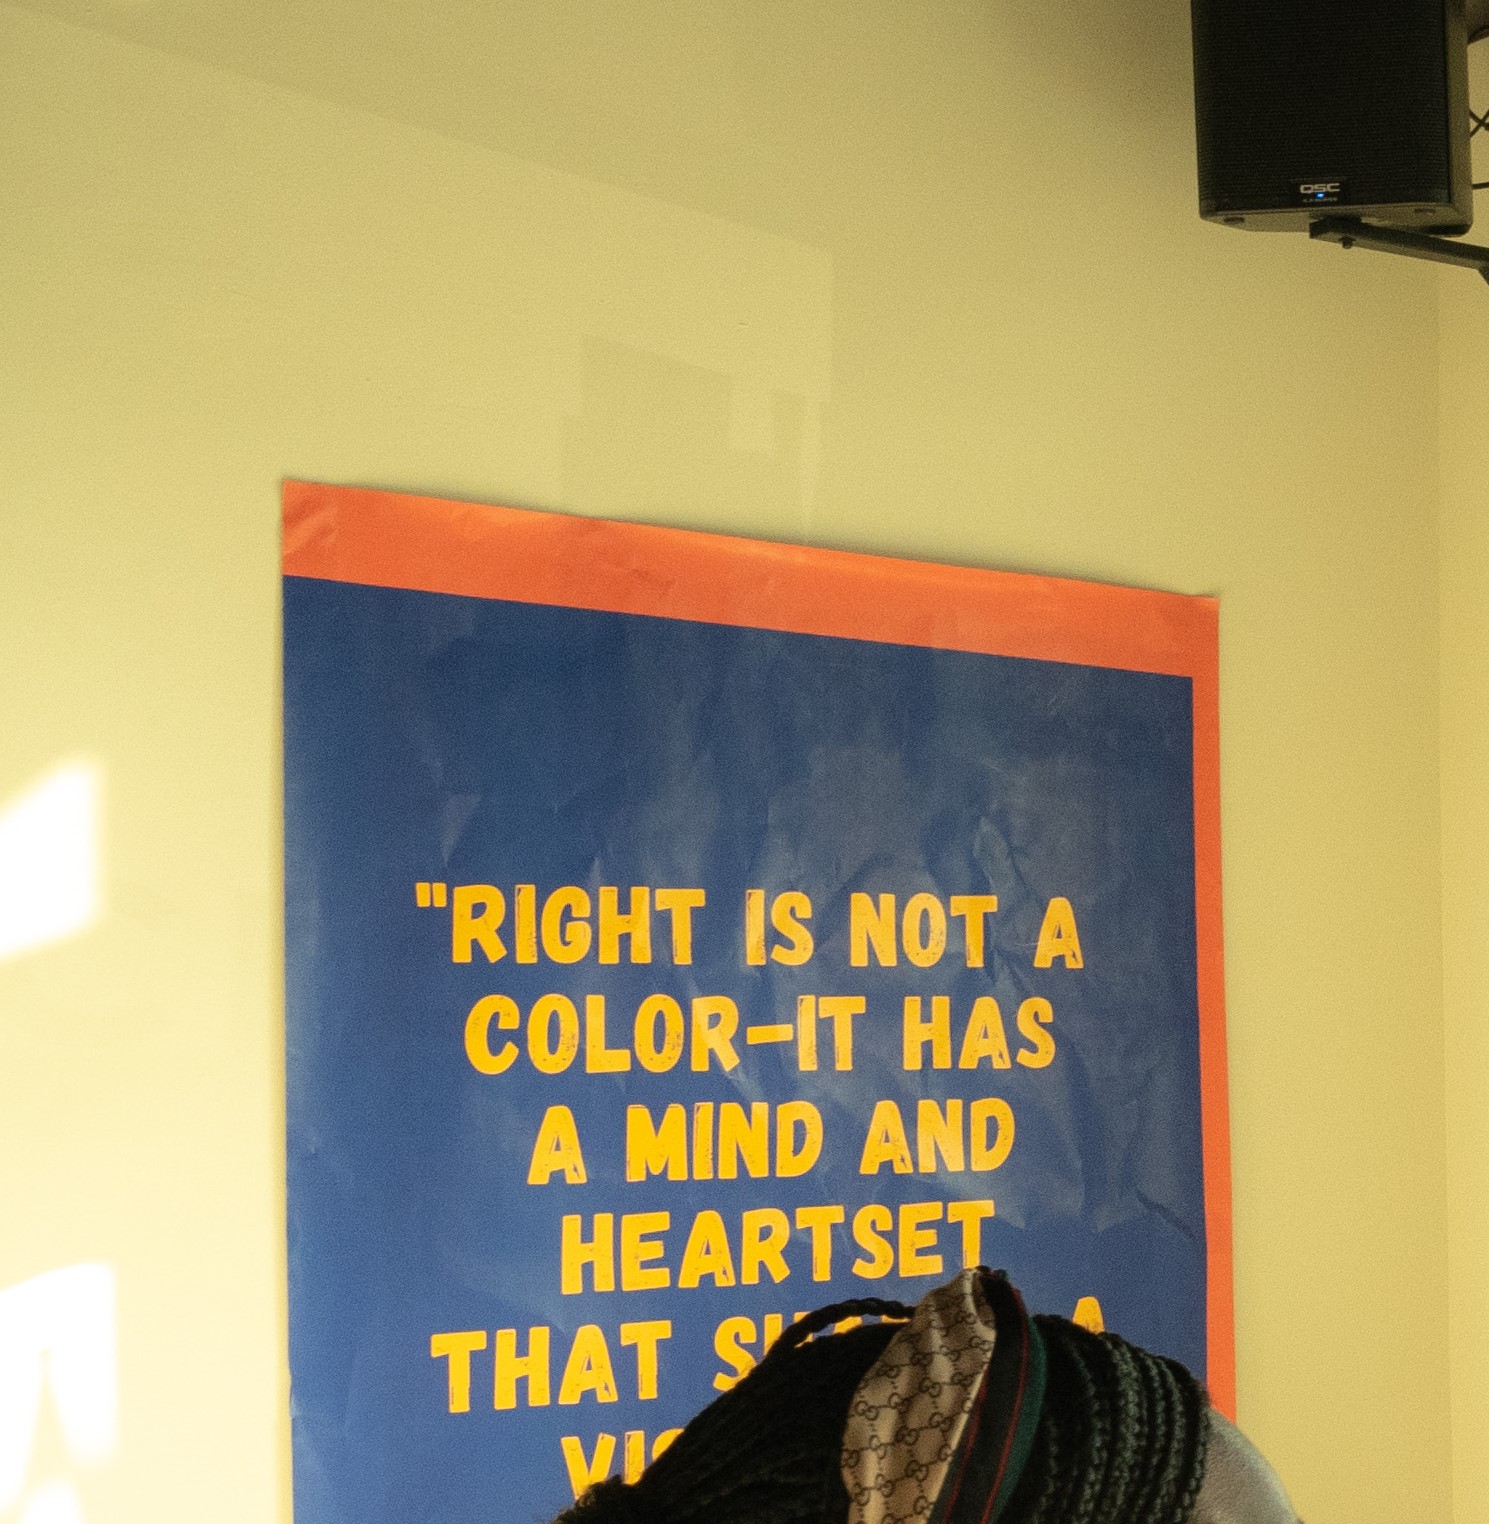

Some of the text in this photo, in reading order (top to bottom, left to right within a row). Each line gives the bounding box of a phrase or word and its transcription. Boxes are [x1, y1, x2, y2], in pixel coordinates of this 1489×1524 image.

[1300, 183, 1341, 194] QSC
[415, 881, 1085, 970] "RIGHT IS NOT A
[463, 993, 1056, 1075] COLOR-IT HAS
[527, 1097, 1016, 1185] A MIND AND
[560, 1200, 996, 1294] HEARTSET
[430, 1318, 673, 1413] THAT
